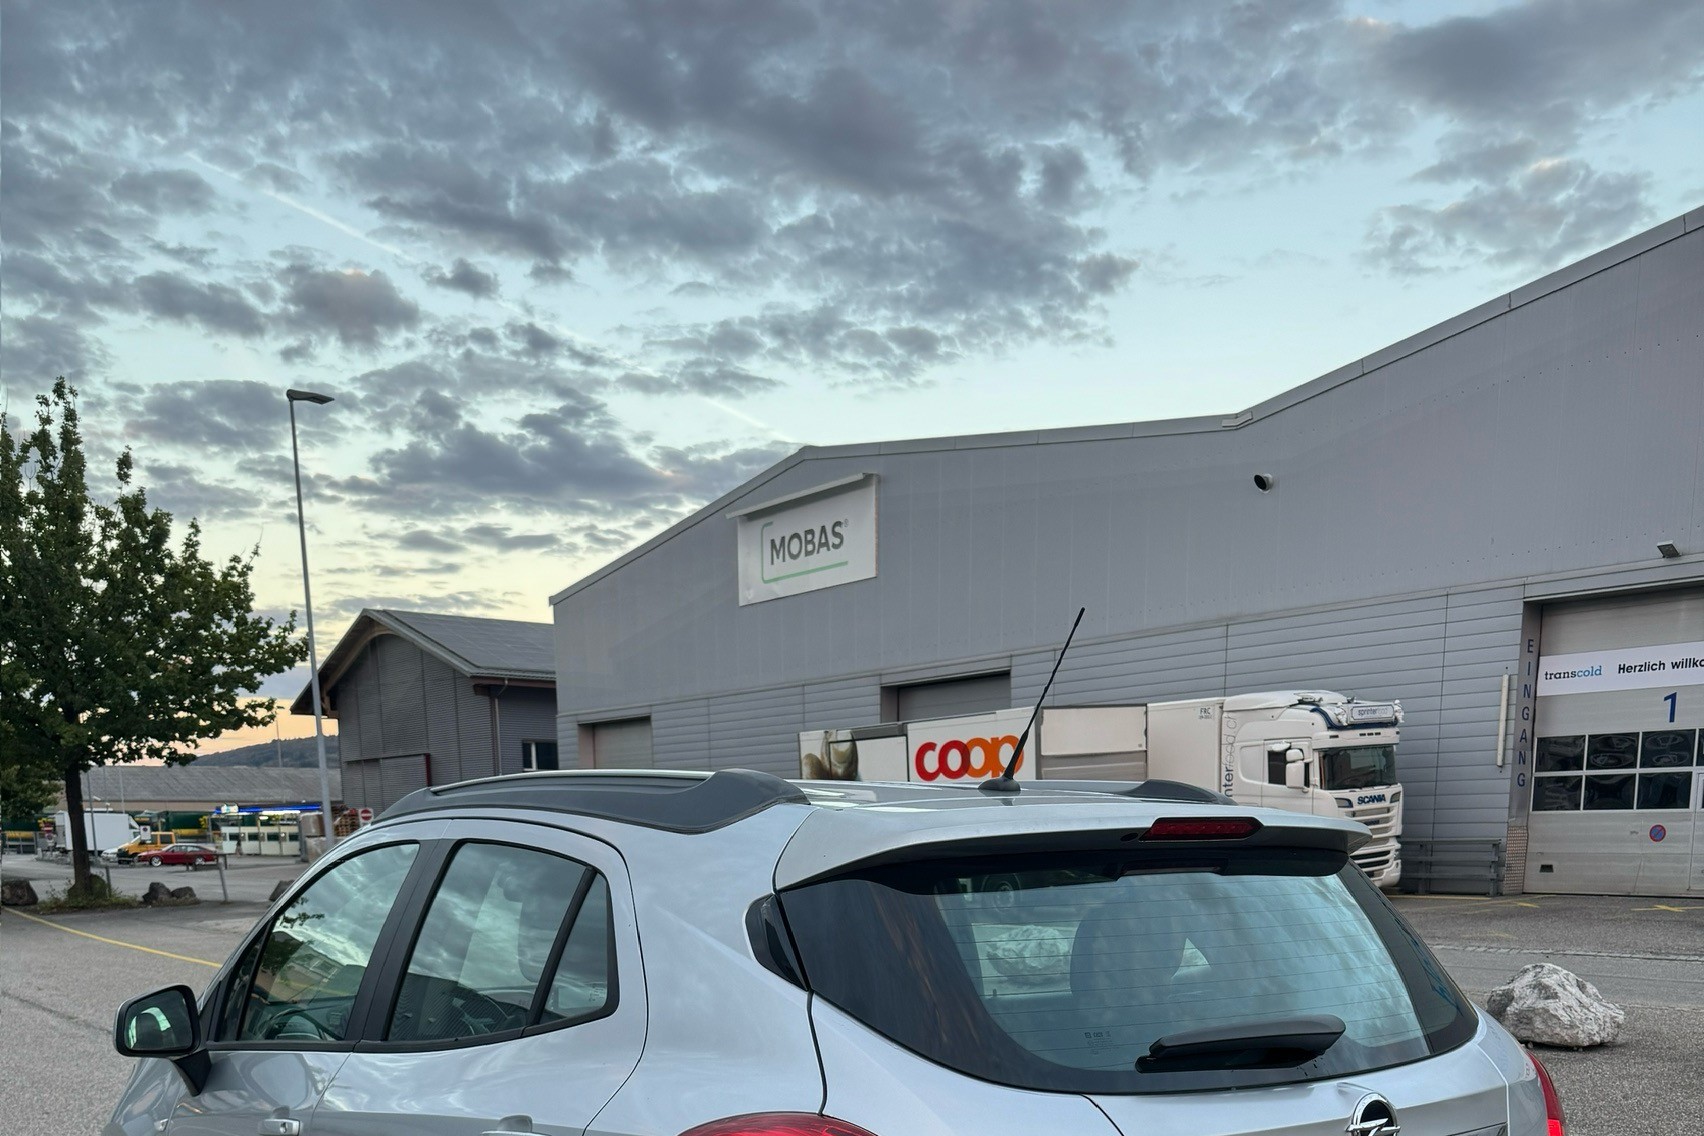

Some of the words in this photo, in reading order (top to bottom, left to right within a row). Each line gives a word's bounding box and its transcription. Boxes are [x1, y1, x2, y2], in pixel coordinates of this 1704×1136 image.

[1545, 665, 1602, 680] transcold
[1618, 660, 1666, 674] Herzlich
[1517, 639, 1534, 788] EINGANG
[1663, 692, 1677, 722] 1
[915, 735, 1024, 782] coop
[1357, 794, 1386, 804] SCANIA
